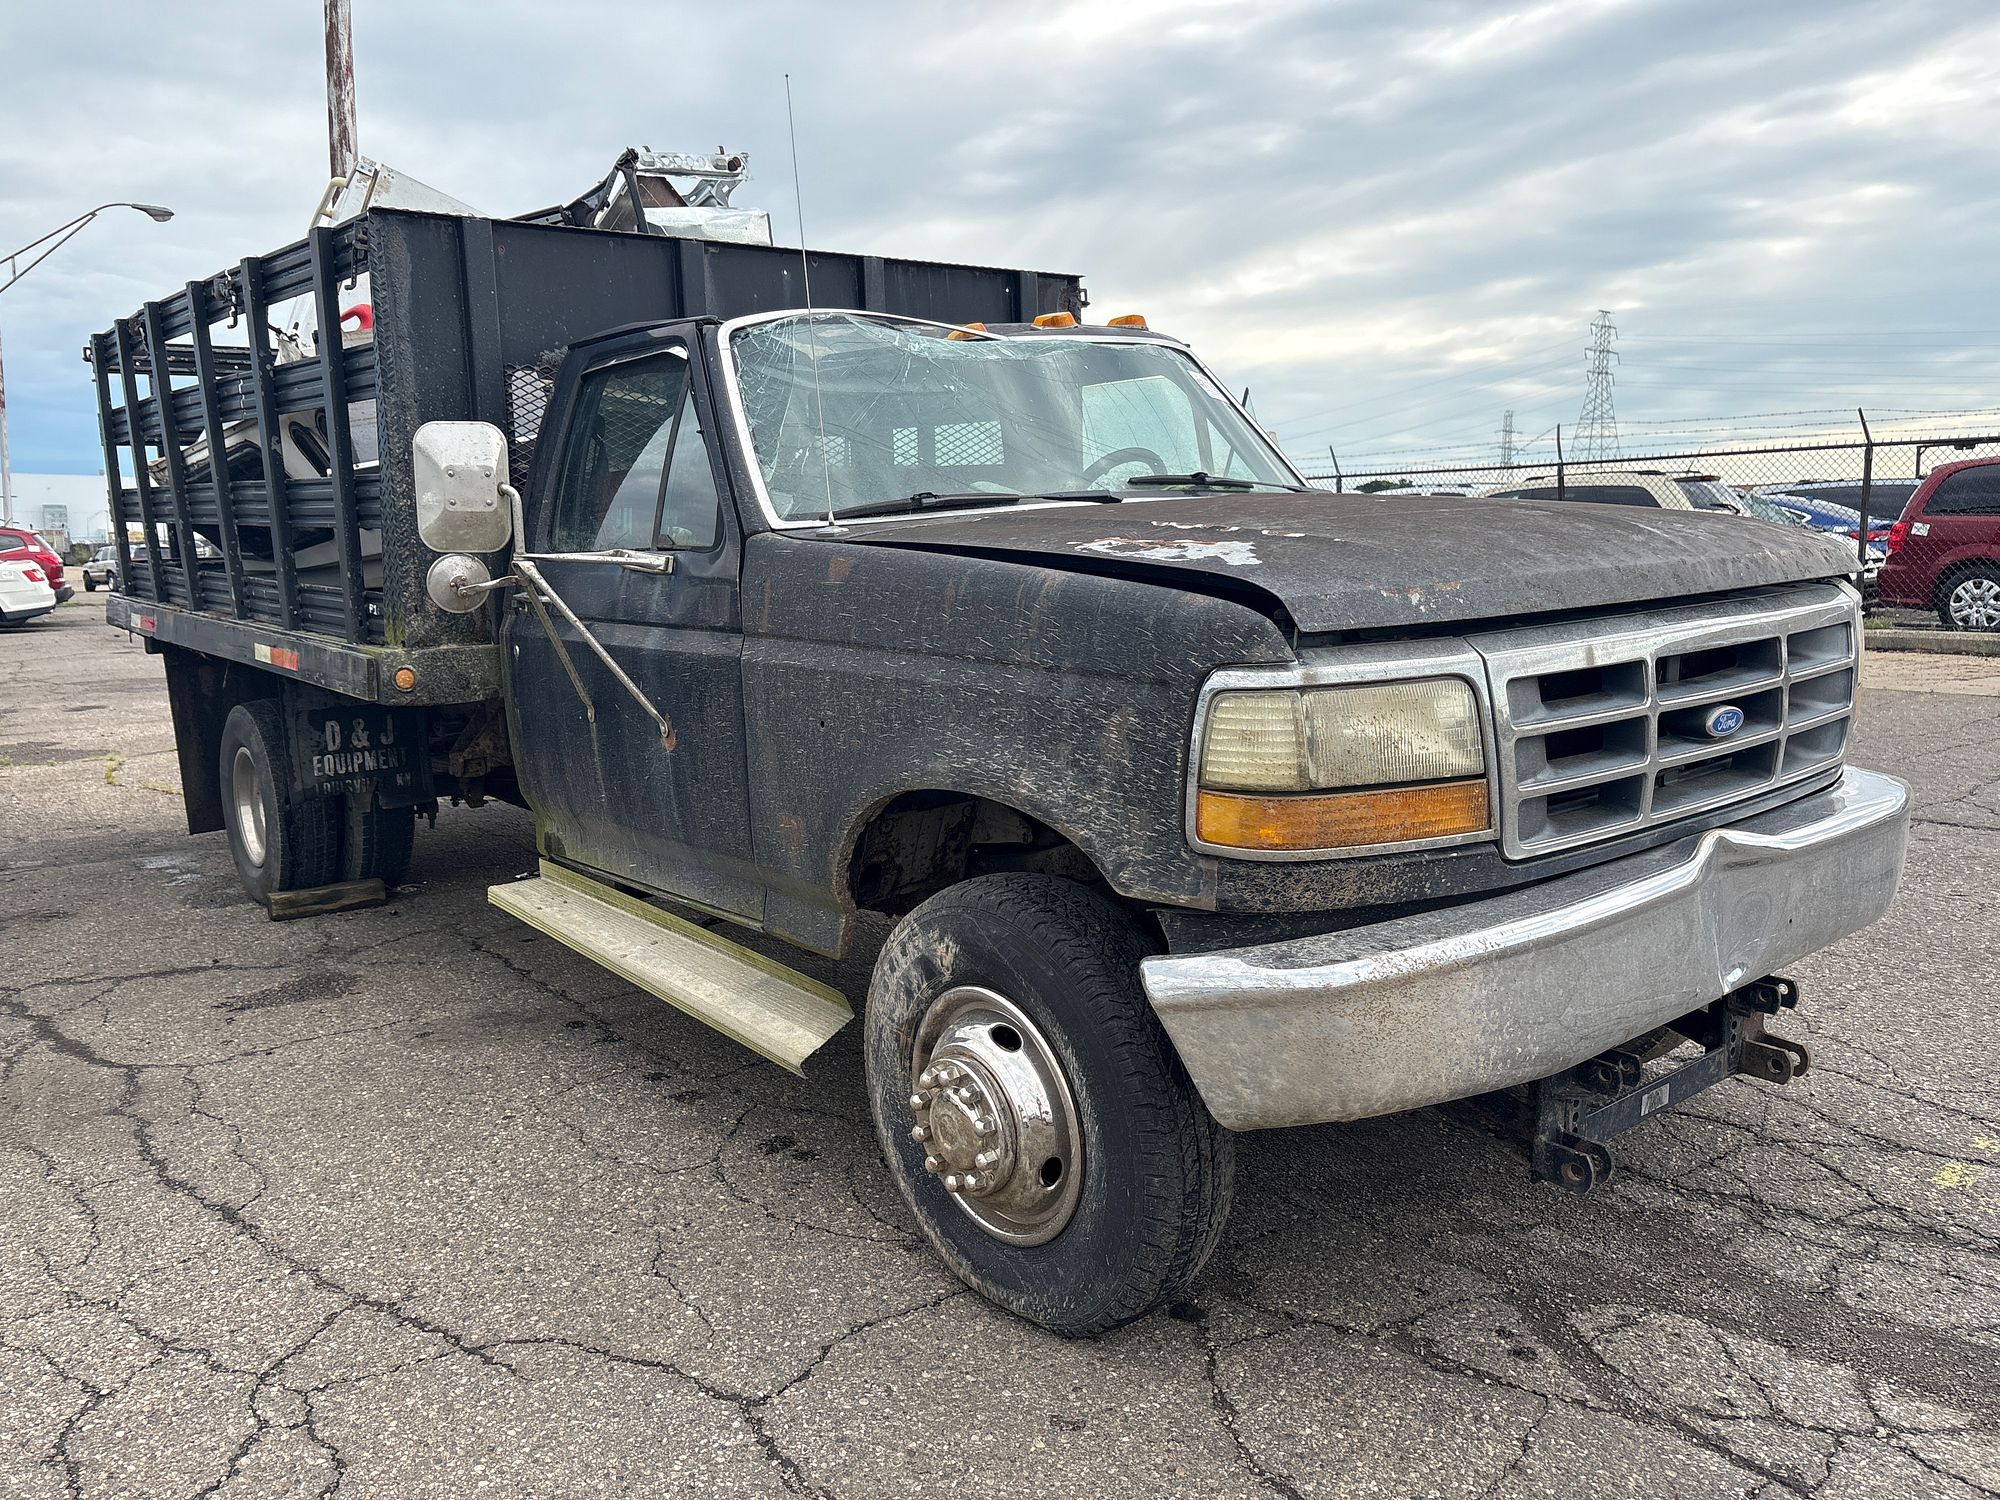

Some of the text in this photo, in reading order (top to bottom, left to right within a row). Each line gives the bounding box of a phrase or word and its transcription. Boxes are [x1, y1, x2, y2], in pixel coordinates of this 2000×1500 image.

[324, 713, 394, 752] D & J
[1717, 712, 1738, 731] Ford
[312, 746, 408, 777] EQUIPMENT
